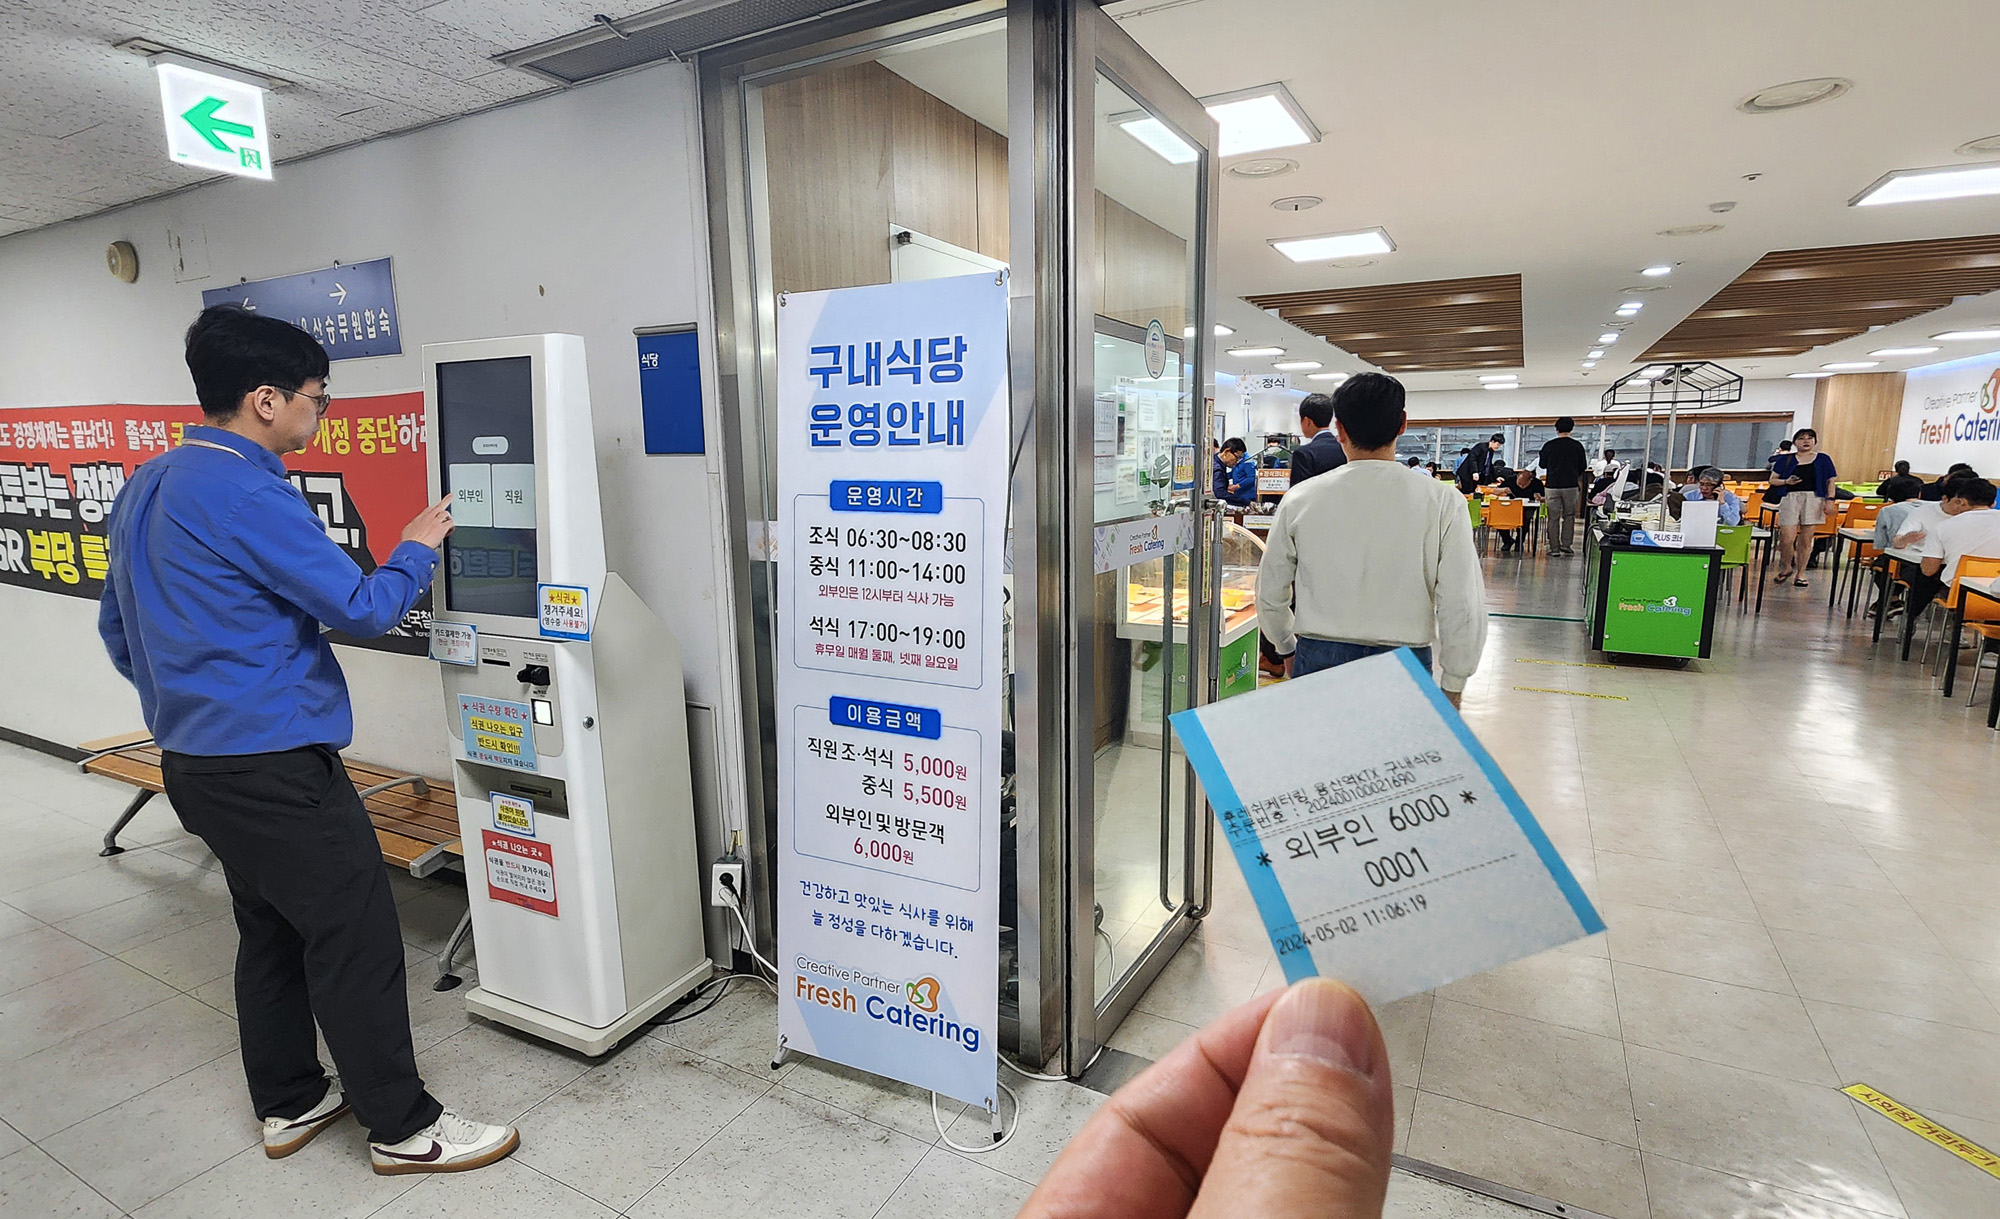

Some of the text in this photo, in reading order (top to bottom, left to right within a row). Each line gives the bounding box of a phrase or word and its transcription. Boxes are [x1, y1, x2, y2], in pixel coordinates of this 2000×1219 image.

[641, 353, 659, 367] 식당
[809, 336, 967, 389] 구내식당
[1262, 378, 1285, 389] 정식
[12, 420, 70, 450] 경쟁체제는
[71, 418, 115, 450] 끝났다!
[124, 419, 169, 453] 졸속적
[809, 400, 964, 447] 운영안내
[1919, 416, 1951, 445] Fresh
[0, 464, 72, 520] 토부는
[458, 489, 523, 504] 외부인 직원
[847, 486, 924, 508] 운영시간
[808, 526, 967, 553] 조식 06:30~08:30
[1129, 540, 1164, 555] Fresh Catering
[1653, 533, 1670, 542] PLUS
[26, 529, 80, 584] 부당
[808, 556, 966, 584] 중식 11:00~14:00
[555, 592, 573, 604] 식권
[818, 585, 955, 608] 외부인은 12시부터 식사 가능
[1618, 602, 1692, 616] Fresh Catering
[543, 604, 584, 618] 챙겨주세요!
[562, 620, 588, 630] 사용불가)
[434, 628, 472, 640] 카드결제만 가능
[808, 616, 966, 650] 석식 17:00~19:00
[815, 643, 959, 671] 휴무일 매월 둘째, 넷째 일요일
[472, 702, 519, 719] 식권 수량 확인
[847, 704, 922, 732] 이용금액
[471, 719, 523, 737] 식권 나오는 입구
[477, 737, 498, 749] 반드시
[807, 737, 838, 761] 직원
[903, 753, 967, 781] 5,000원
[1313, 768, 1380, 796] 용산역KTX
[1384, 750, 1442, 776] 구내식당
[862, 774, 967, 811] 중식 5,500원
[826, 803, 945, 845] 외부인 및 방문객
[1228, 809, 1289, 838] 주문번호
[1285, 794, 1450, 860] 외부인 6000
[496, 839, 537, 856] 식권 나오는 곳
[853, 837, 914, 866] 6,000원
[488, 856, 551, 879] 식권을 반드시 챙겨주세요!
[1363, 847, 1429, 887] 0001
[799, 880, 974, 933] 건강하고 맛있는 식사를 위해
[812, 909, 959, 960] 늘 정성을 다하겠습니다.
[1276, 894, 1428, 956] 2024-05-02 11:06:19
[796, 956, 901, 994] Creative Partner
[796, 975, 980, 1052] Fresh Catering
[1859, 1091, 1997, 1167] 사회적 거리두기
